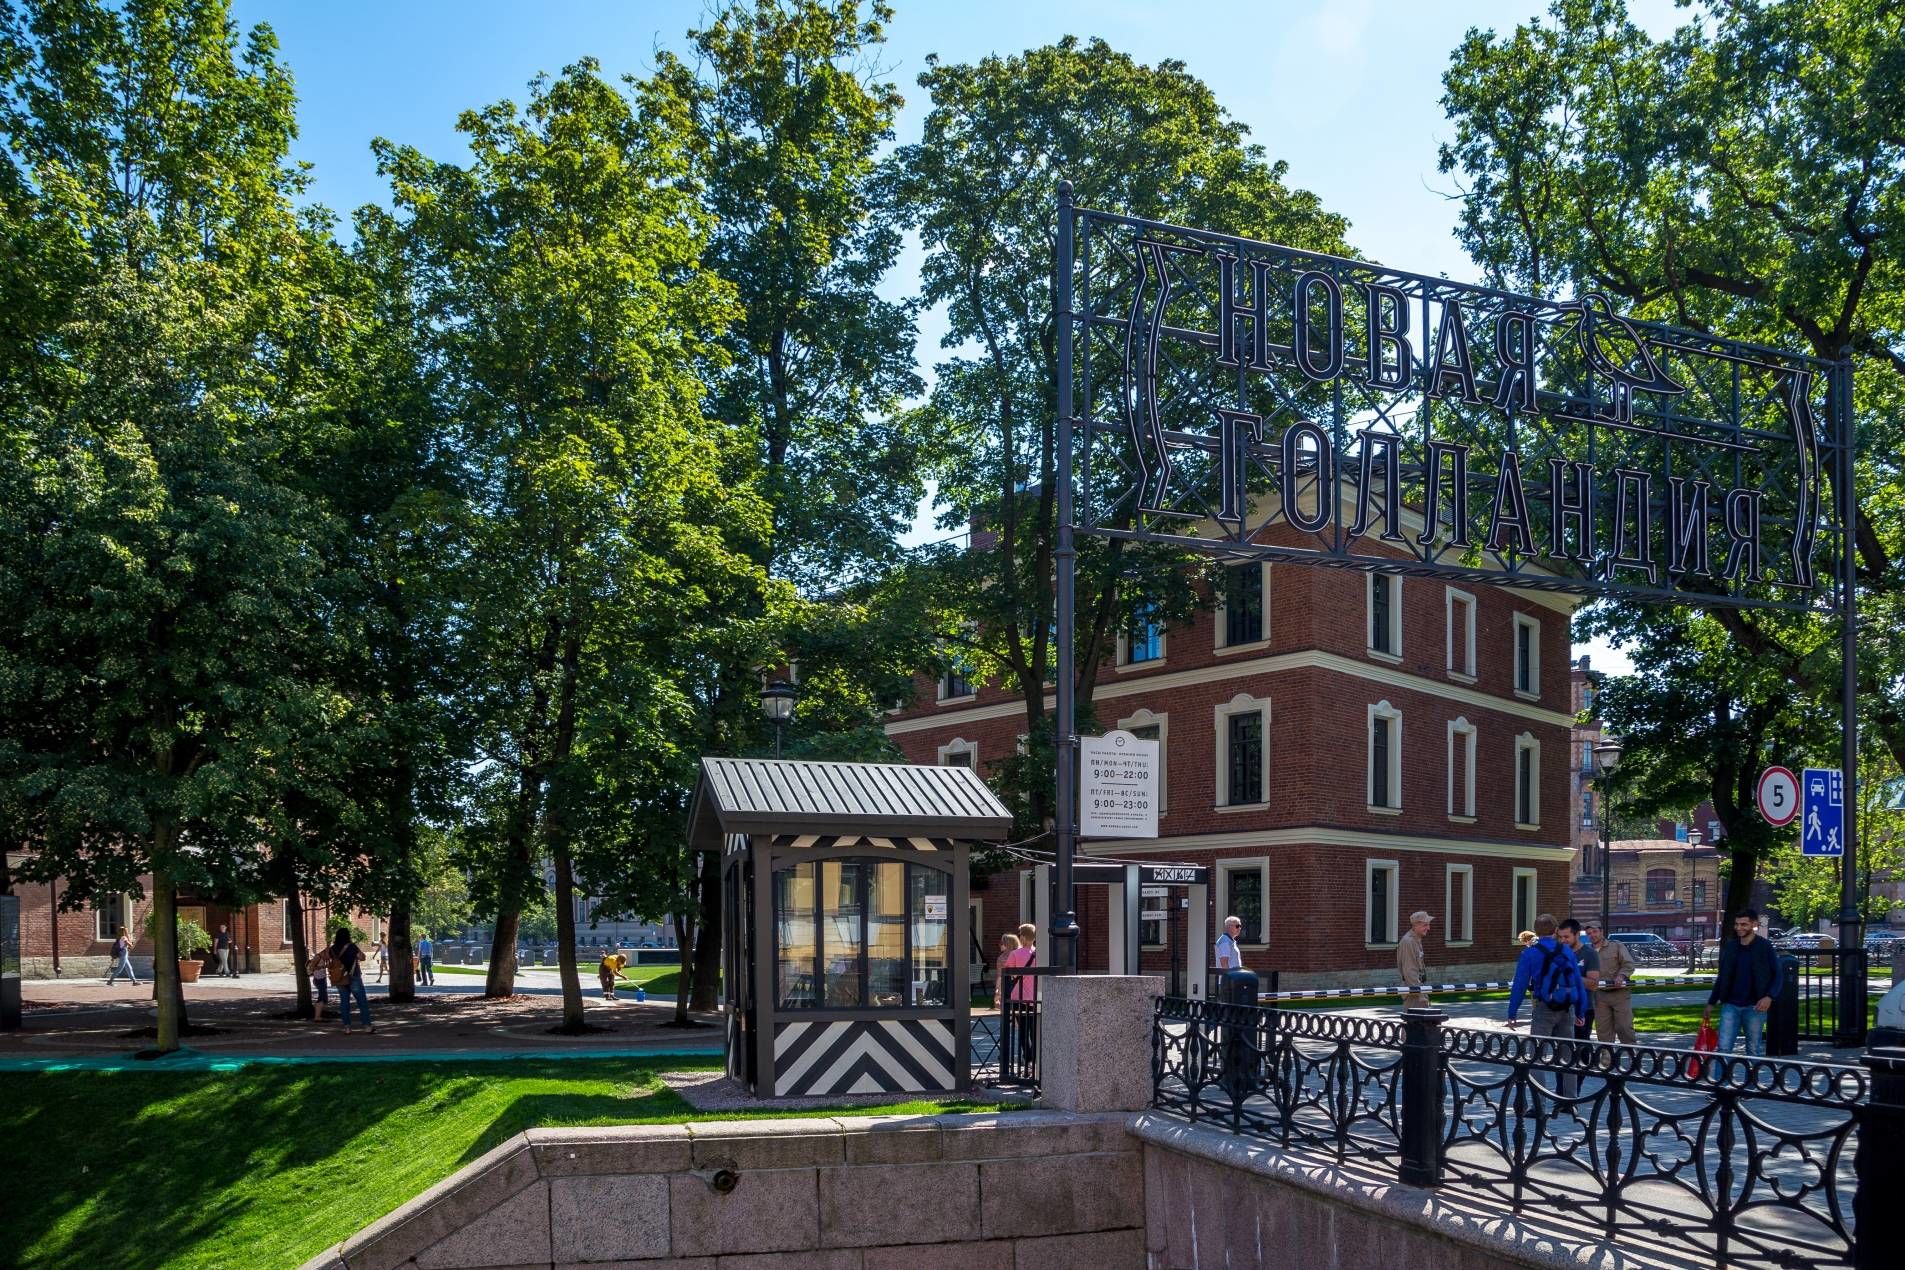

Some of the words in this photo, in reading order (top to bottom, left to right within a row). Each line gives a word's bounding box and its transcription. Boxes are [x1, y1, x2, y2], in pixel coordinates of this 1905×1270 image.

[1215, 251, 1541, 415] НОВАЯ
[1215, 408, 1764, 585] ГОЛЛАНДИЯ
[1772, 784, 1784, 808] 5
